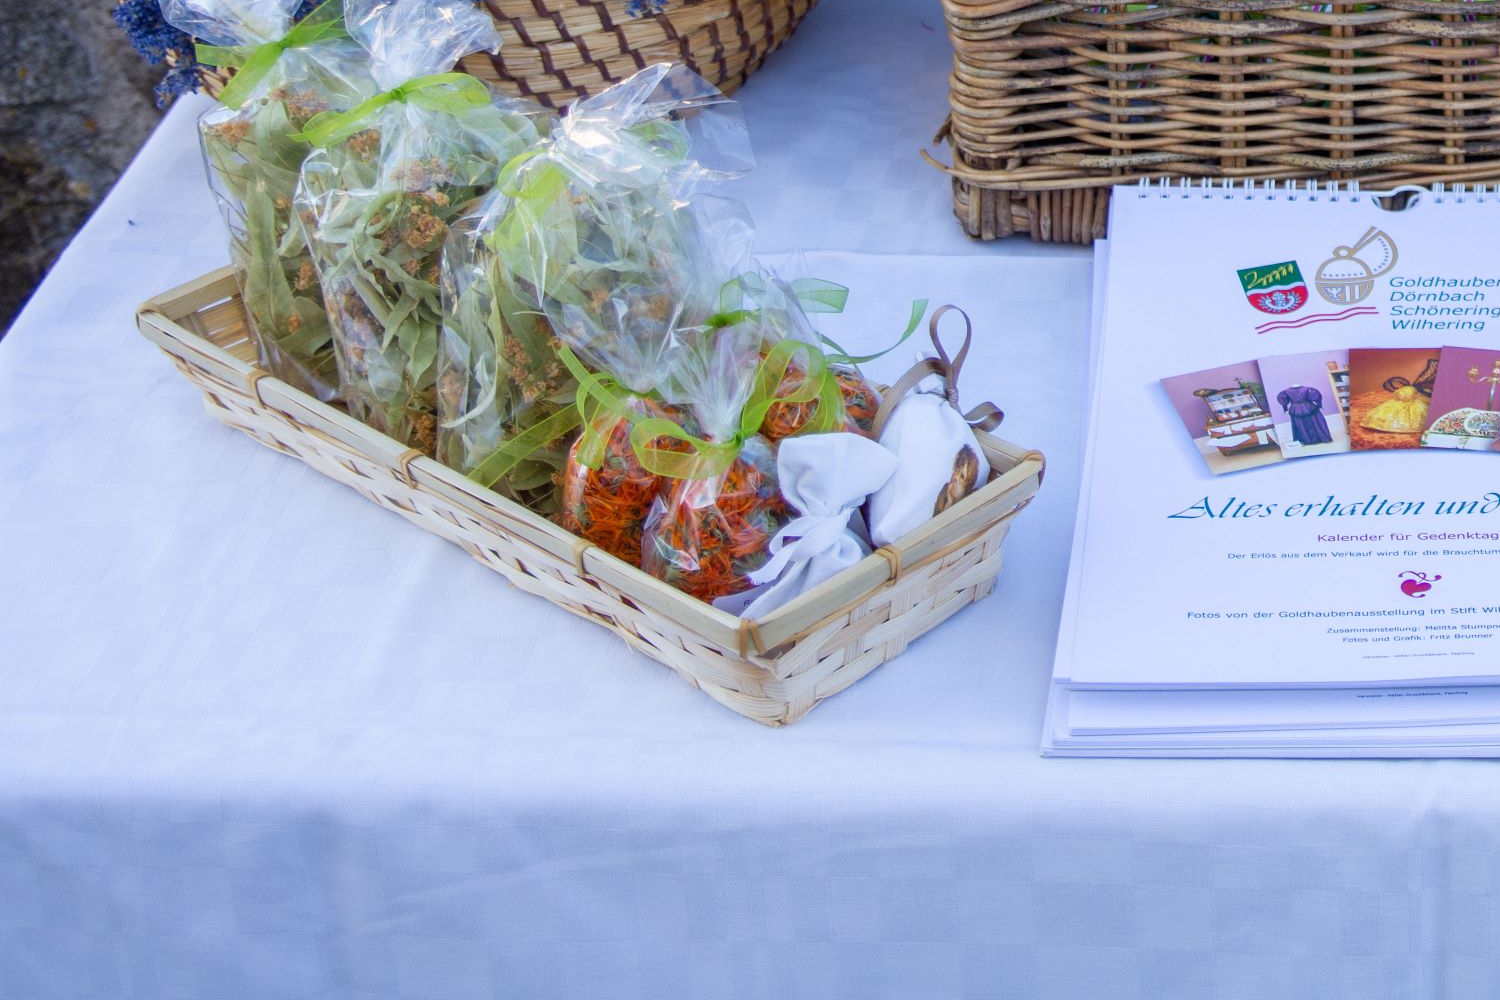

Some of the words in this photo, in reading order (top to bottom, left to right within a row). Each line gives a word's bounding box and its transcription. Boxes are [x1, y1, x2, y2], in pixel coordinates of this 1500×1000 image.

[1389, 290, 1486, 302] Dörnbach
[1391, 319, 1486, 332] Wilhering
[1167, 495, 1279, 519] Altes
[1284, 494, 1425, 518] erhalten
[1317, 533, 1385, 542] Kalender
[1390, 532, 1412, 542] für
[1303, 551, 1328, 559] dem
[1331, 550, 1373, 558] Verkauf
[1376, 549, 1399, 557] wird
[1402, 549, 1419, 557] für
[1187, 611, 1221, 619] Fotos
[1253, 610, 1274, 619] der
[1278, 608, 1425, 619] Goldhaubenausstellung
[1430, 607, 1446, 615] im
[1450, 606, 1478, 615] Stift
[1326, 625, 1422, 634] Zusammenstellung:
[1425, 624, 1458, 632] Melitta
[1429, 633, 1451, 641] Fritz
[1454, 632, 1494, 640] Brunner
